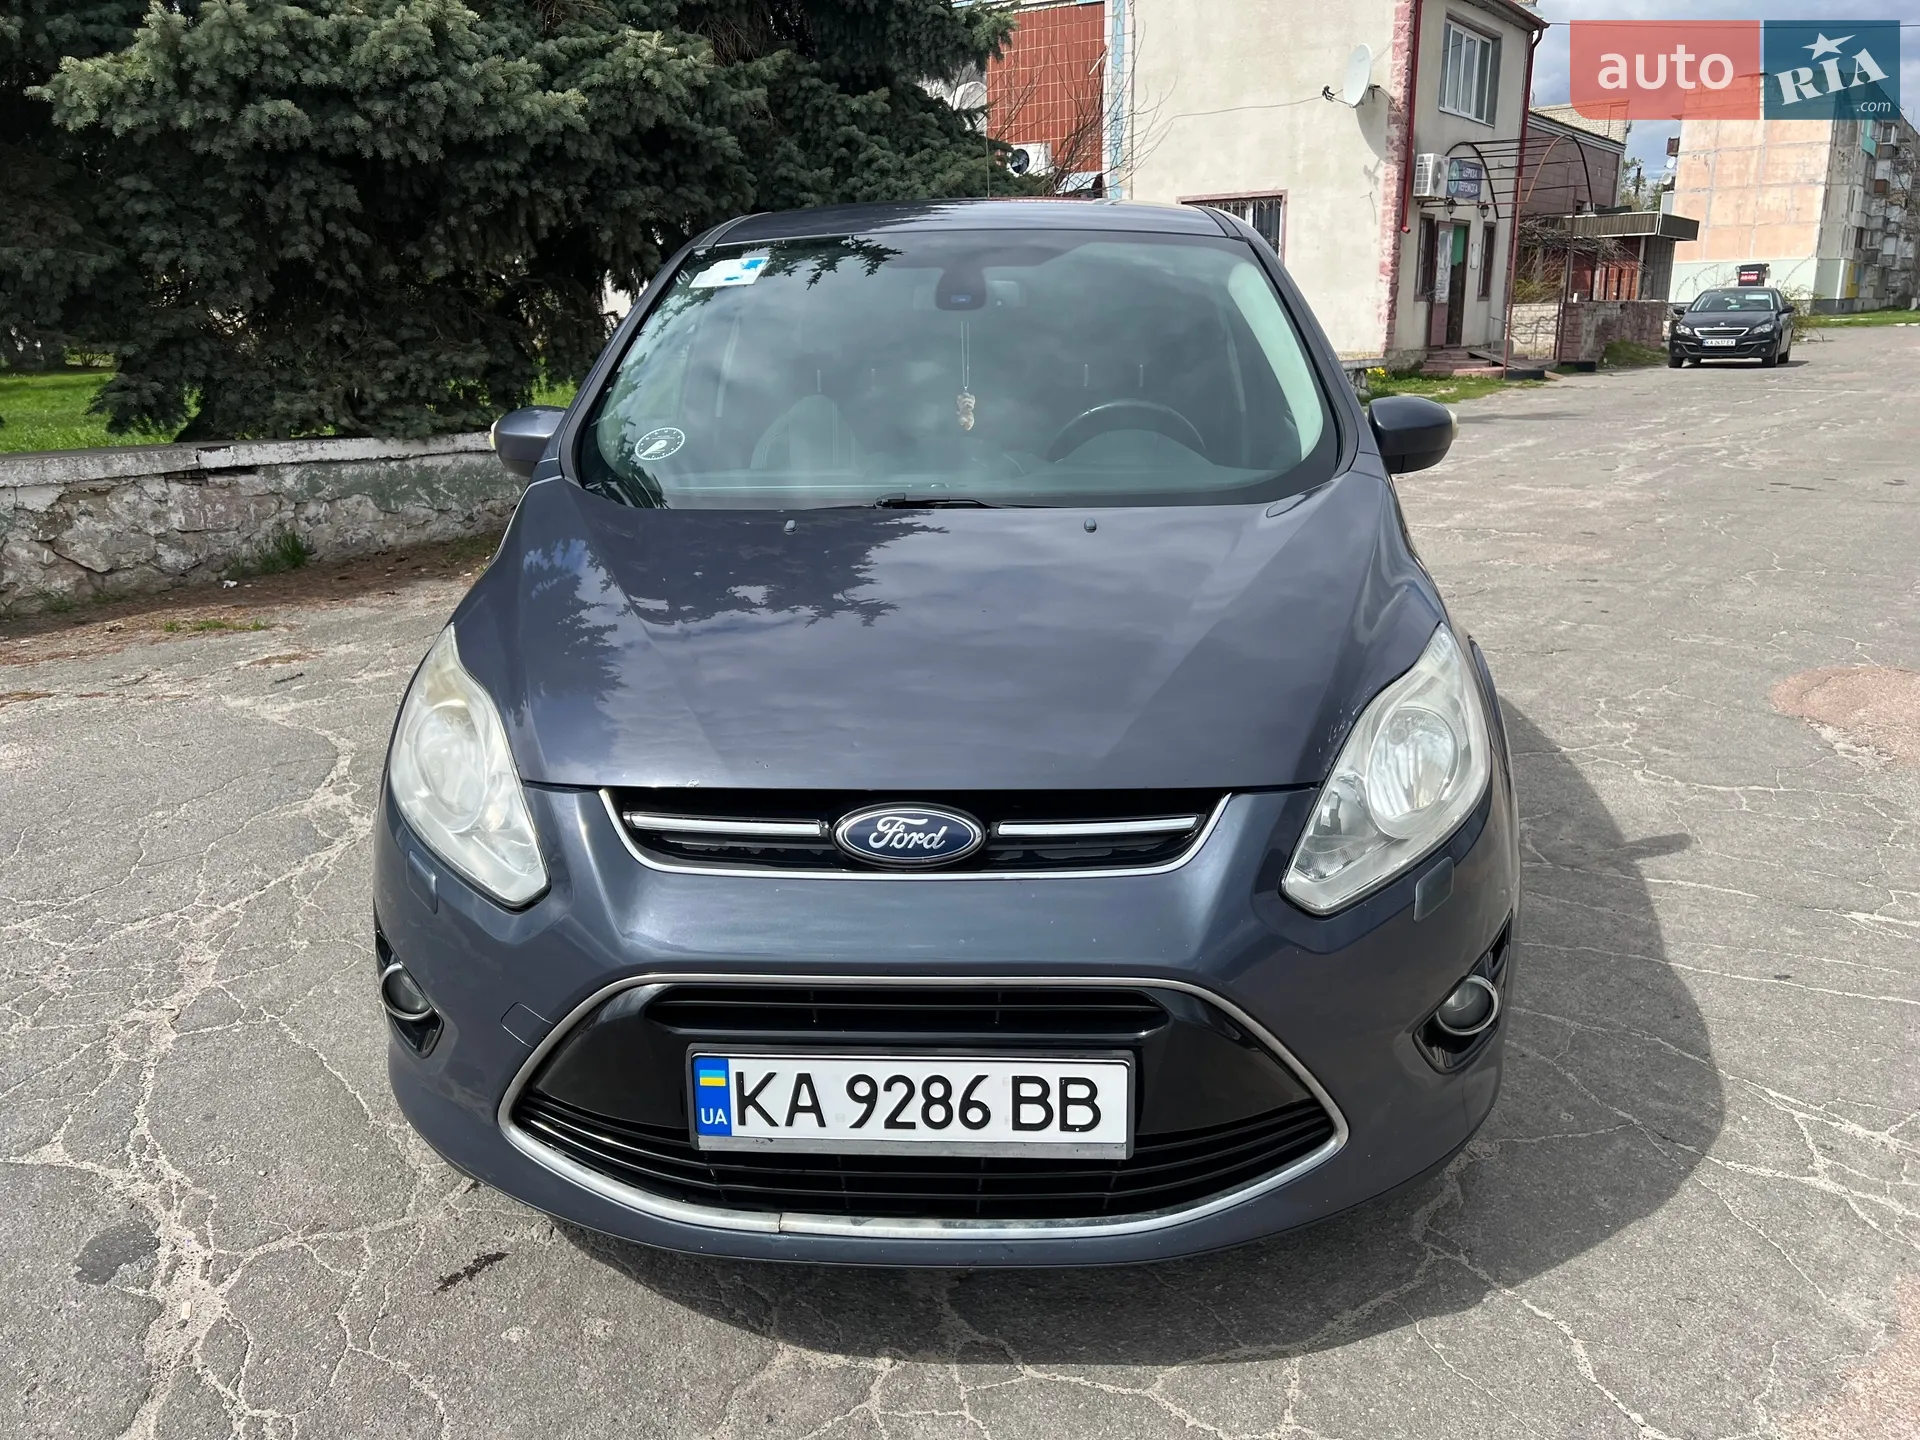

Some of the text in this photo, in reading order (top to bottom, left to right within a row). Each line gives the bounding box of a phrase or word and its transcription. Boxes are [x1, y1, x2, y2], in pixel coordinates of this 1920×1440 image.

[868, 816, 948, 849] Ford
[700, 1108, 728, 1126] UA
[735, 1071, 1102, 1132] KA 9286 BB
